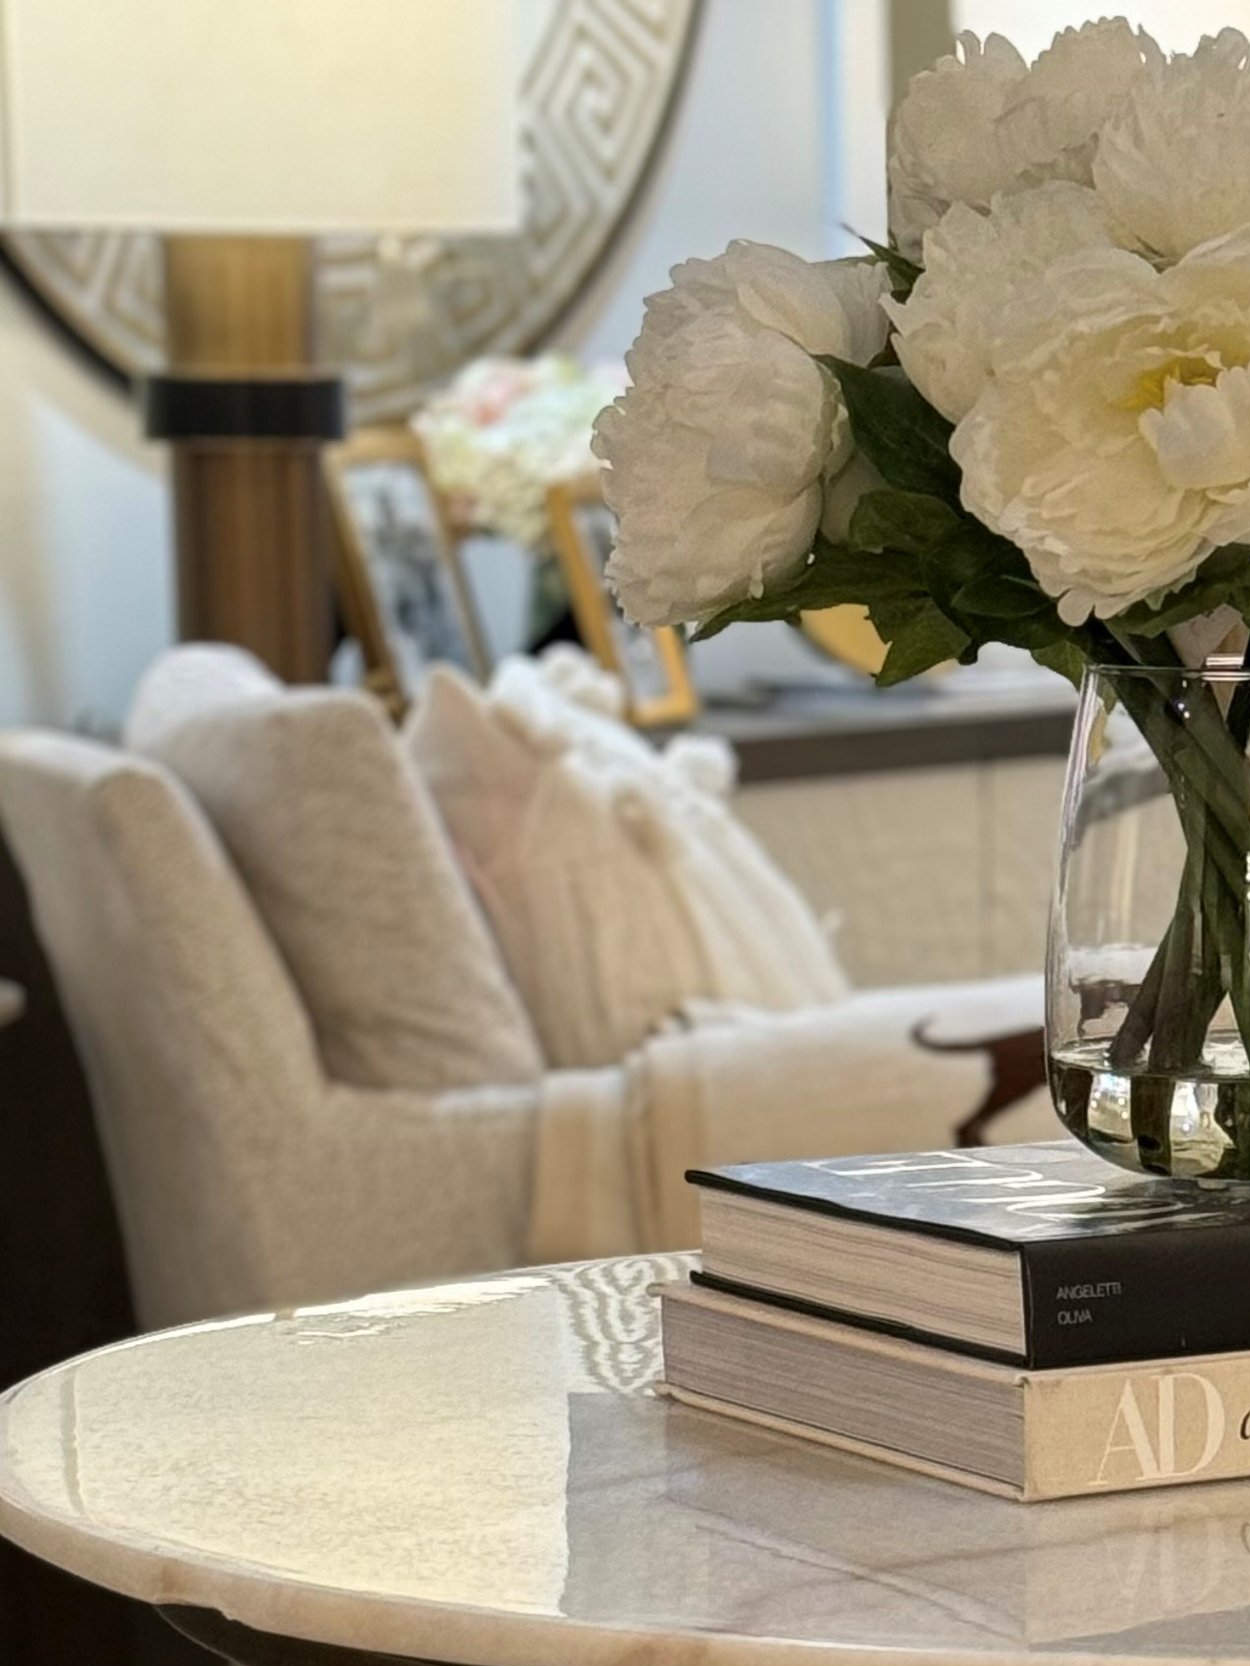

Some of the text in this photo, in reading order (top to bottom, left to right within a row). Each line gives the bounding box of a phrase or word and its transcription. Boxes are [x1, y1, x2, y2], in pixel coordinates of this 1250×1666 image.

[1056, 1281, 1121, 1300] ANGELETTI
[1057, 1308, 1093, 1326] OLIVA
[1088, 1372, 1225, 1486] AD
